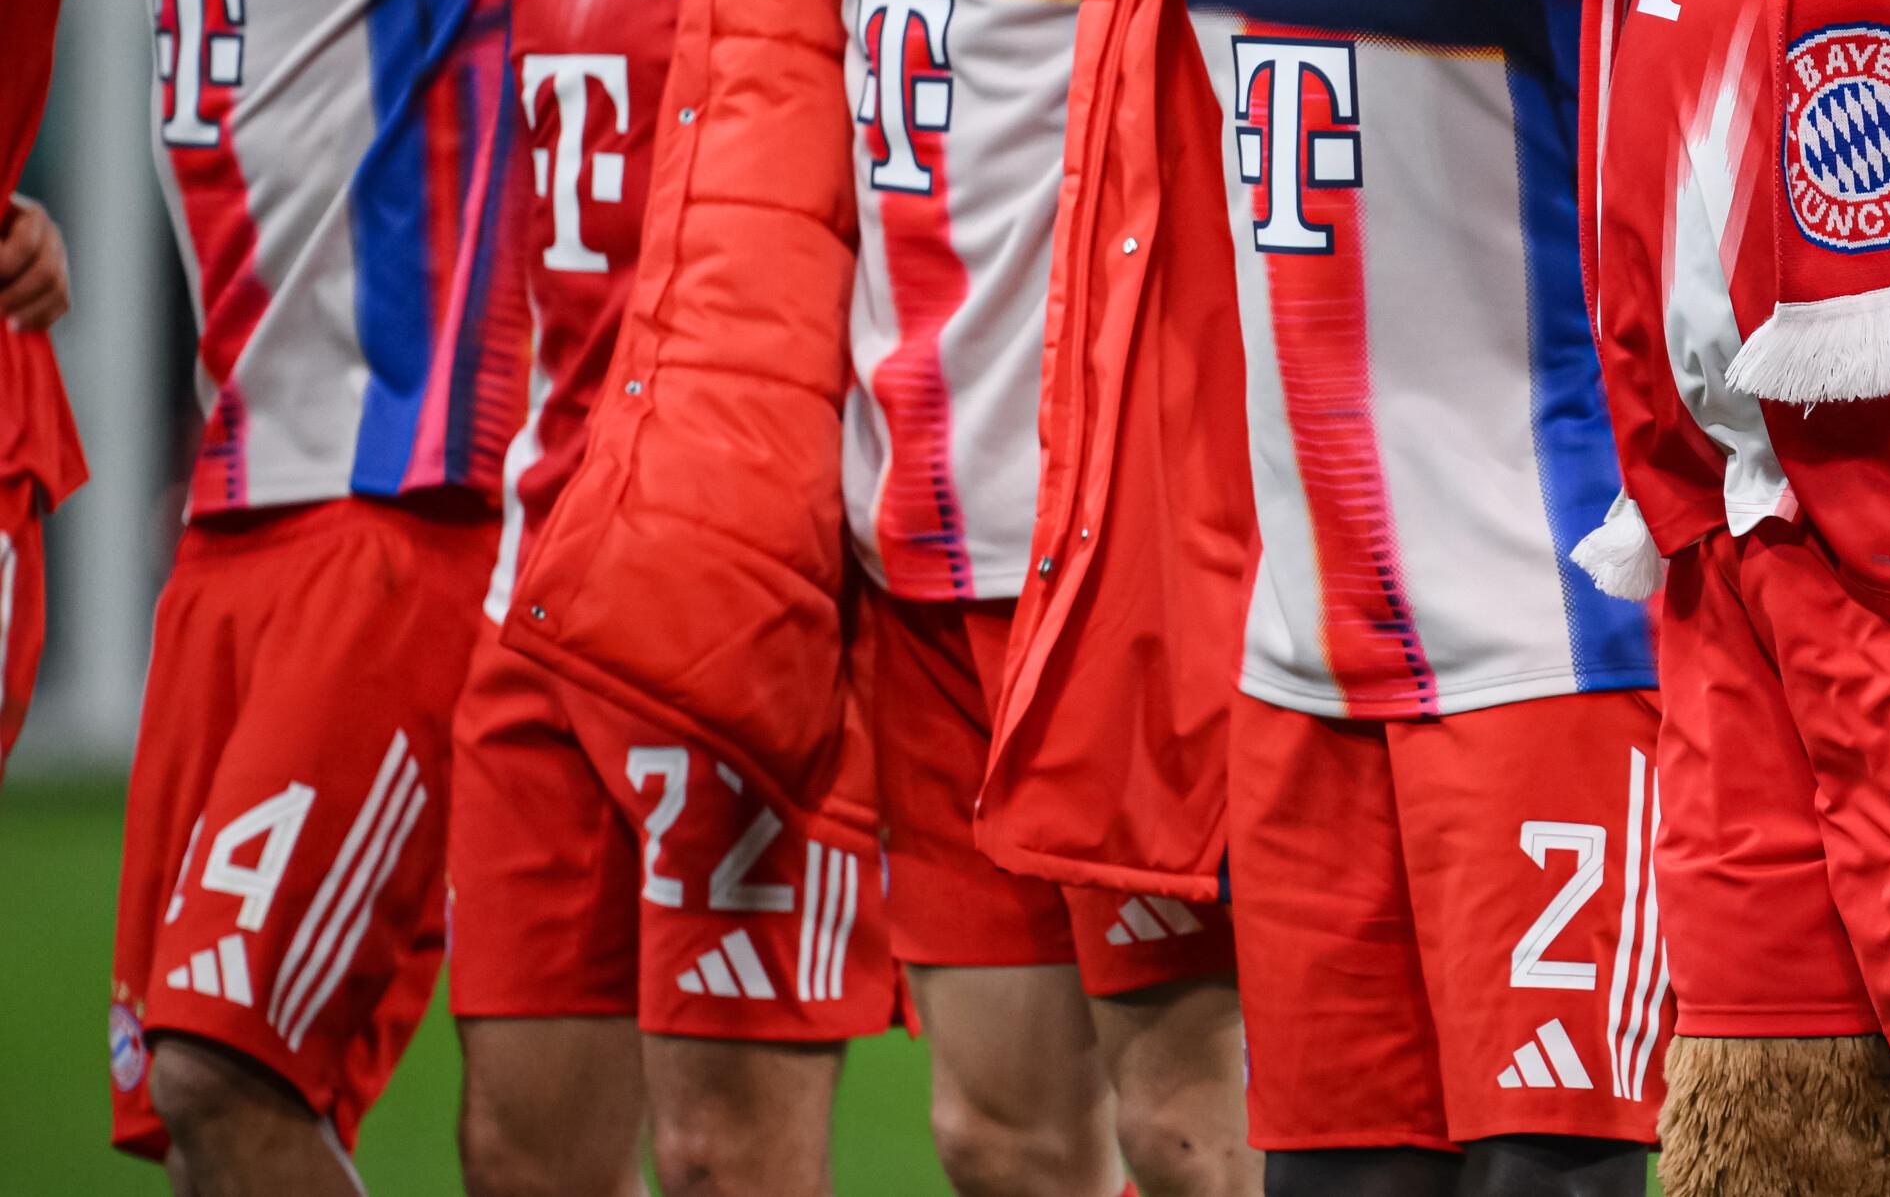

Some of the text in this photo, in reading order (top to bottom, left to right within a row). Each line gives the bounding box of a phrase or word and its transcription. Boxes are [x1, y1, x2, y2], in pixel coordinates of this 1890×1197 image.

[522, 54, 628, 273] T
[1231, 34, 1363, 255] T
[1510, 820, 1606, 991] 2
